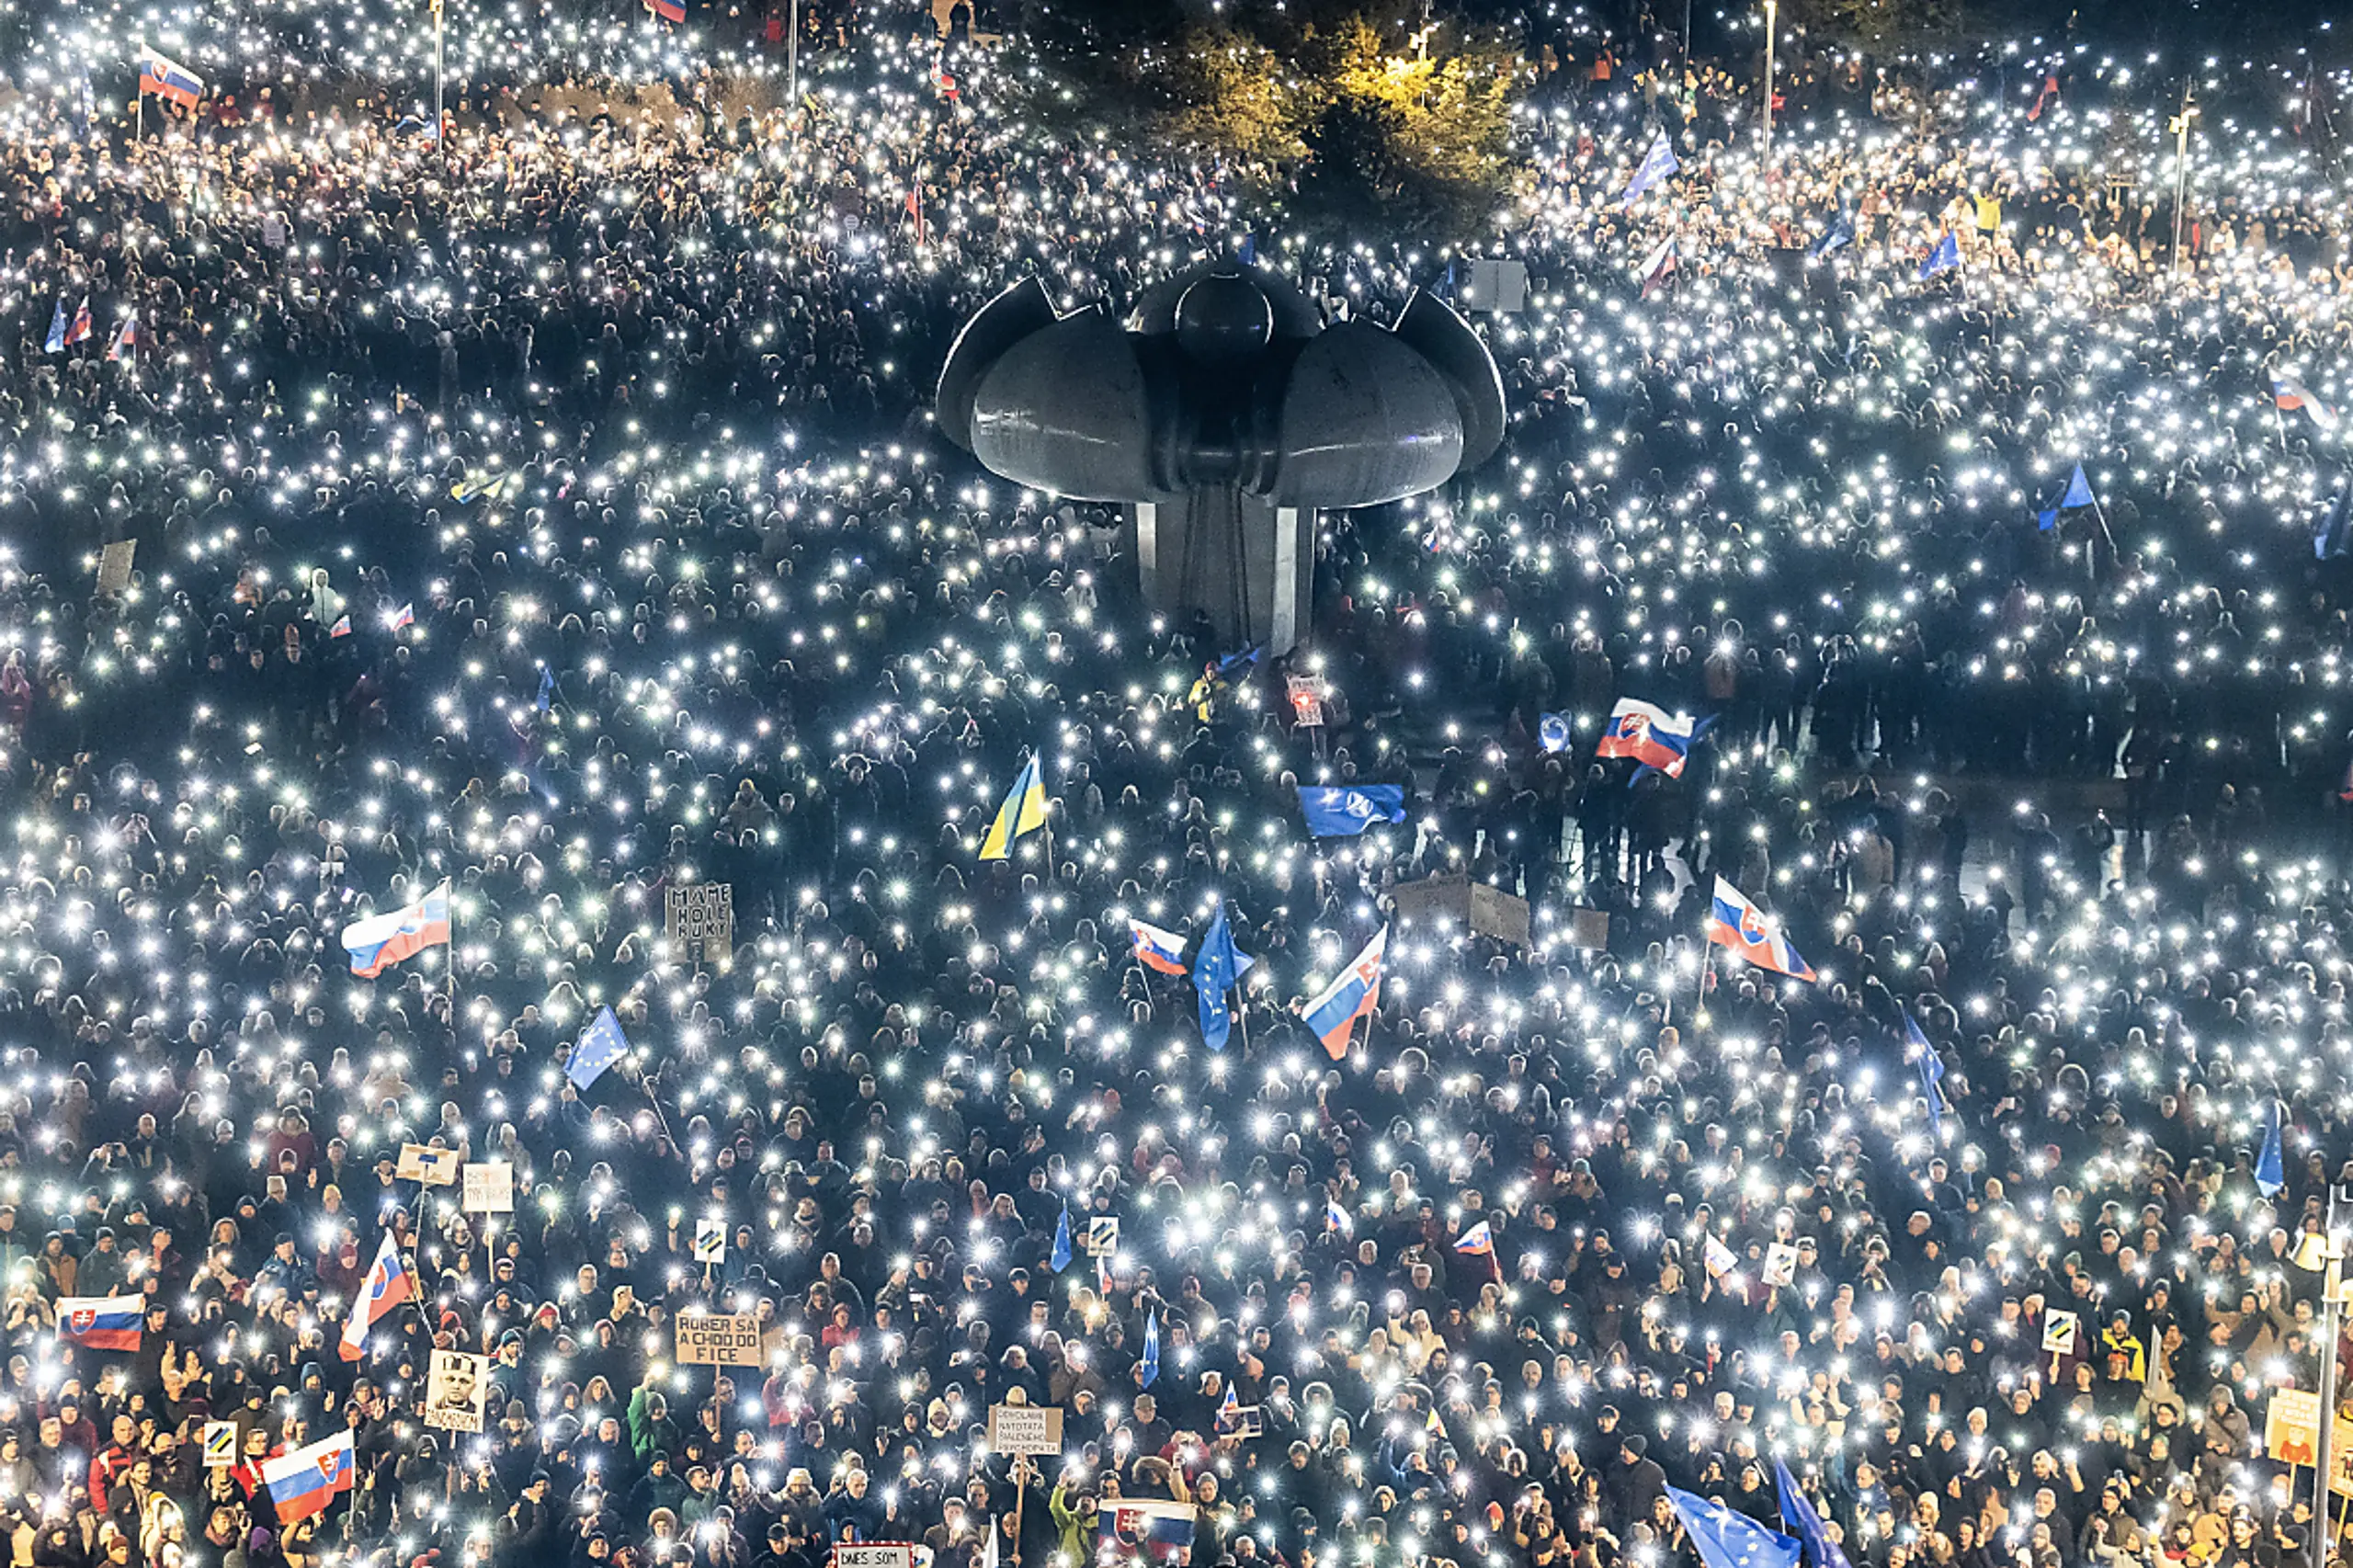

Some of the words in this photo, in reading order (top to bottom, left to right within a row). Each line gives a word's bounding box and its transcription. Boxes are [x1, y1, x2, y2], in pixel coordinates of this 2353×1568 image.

[736, 1318, 756, 1333] SA
[679, 1332, 689, 1345] A
[736, 1334, 756, 1347] DO
[696, 1346, 739, 1363] FICE
[841, 1551, 869, 1565] DNES
[874, 1551, 897, 1565] SOM
